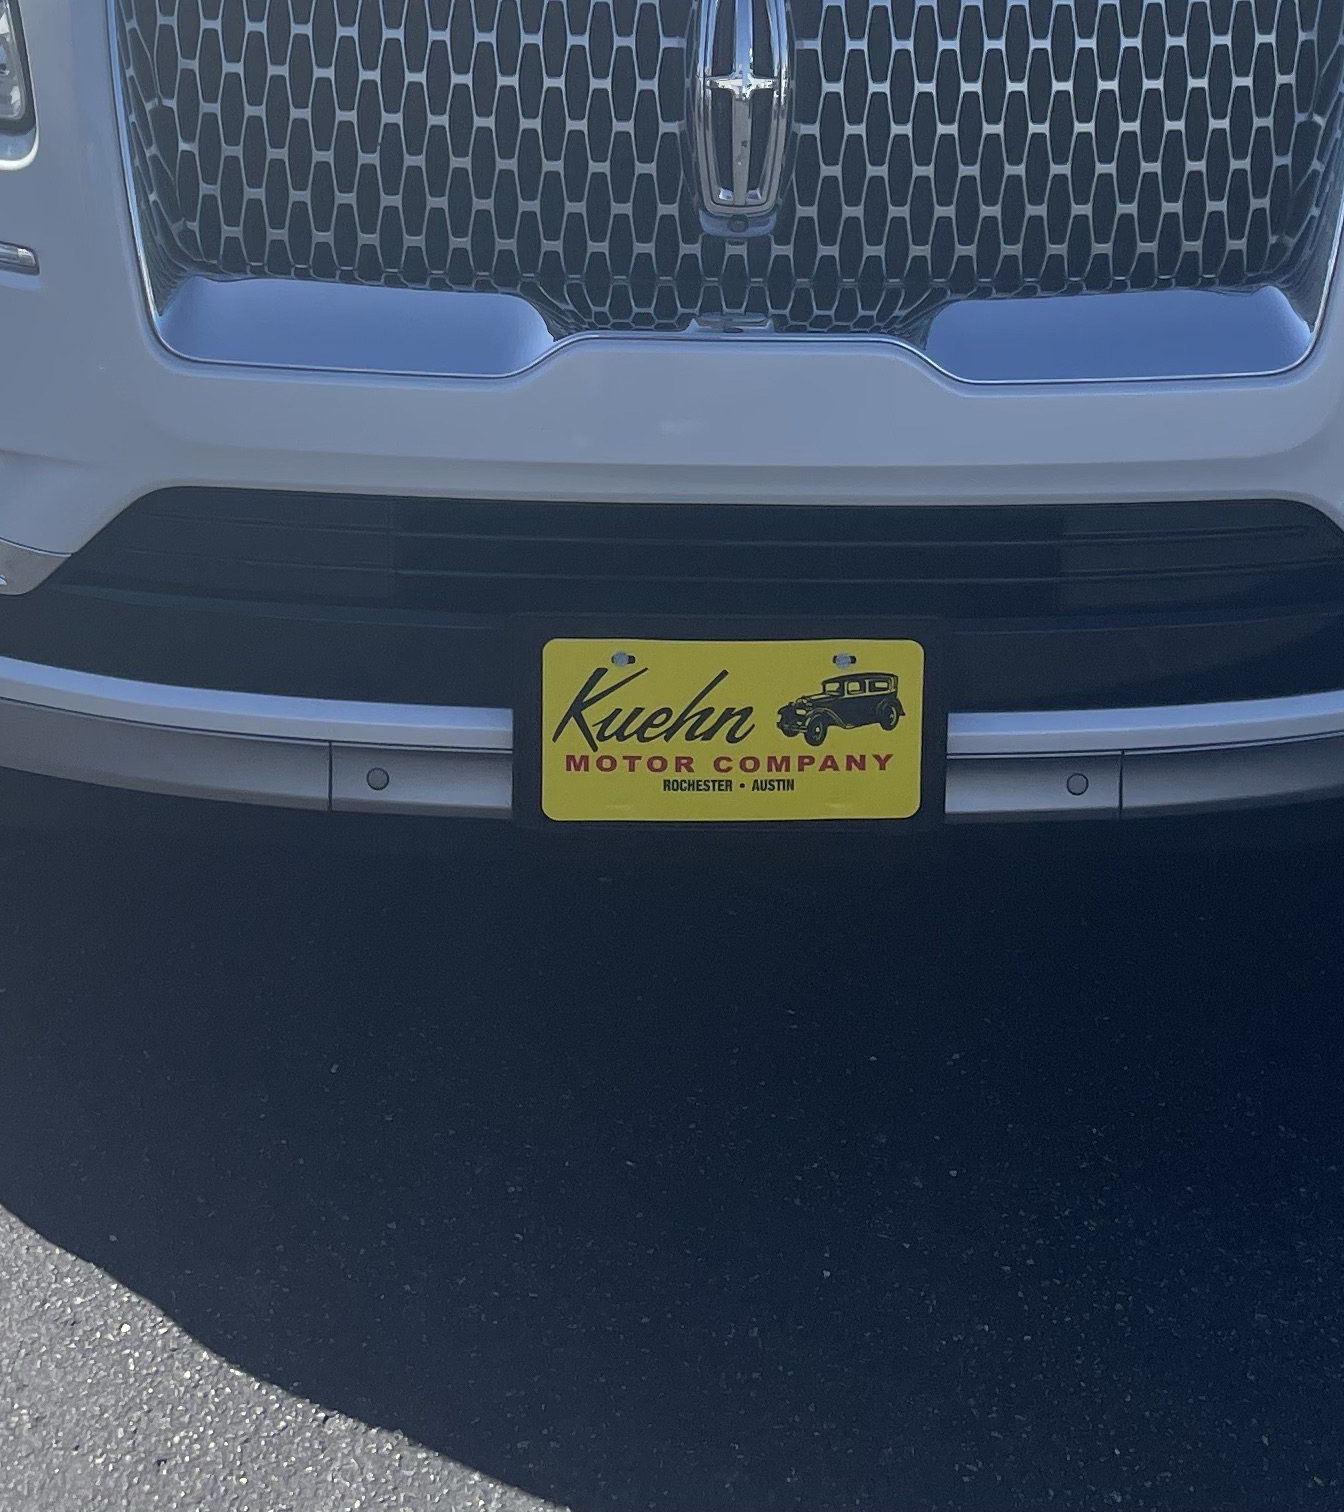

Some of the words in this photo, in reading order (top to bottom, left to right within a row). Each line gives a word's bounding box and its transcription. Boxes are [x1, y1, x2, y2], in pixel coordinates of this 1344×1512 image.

[552, 666, 755, 752] Kuehn
[565, 754, 695, 773] MOTOR
[713, 753, 894, 773] COMPANY
[663, 779, 733, 792] ROCHESTER
[751, 778, 795, 792] AUSTIN
